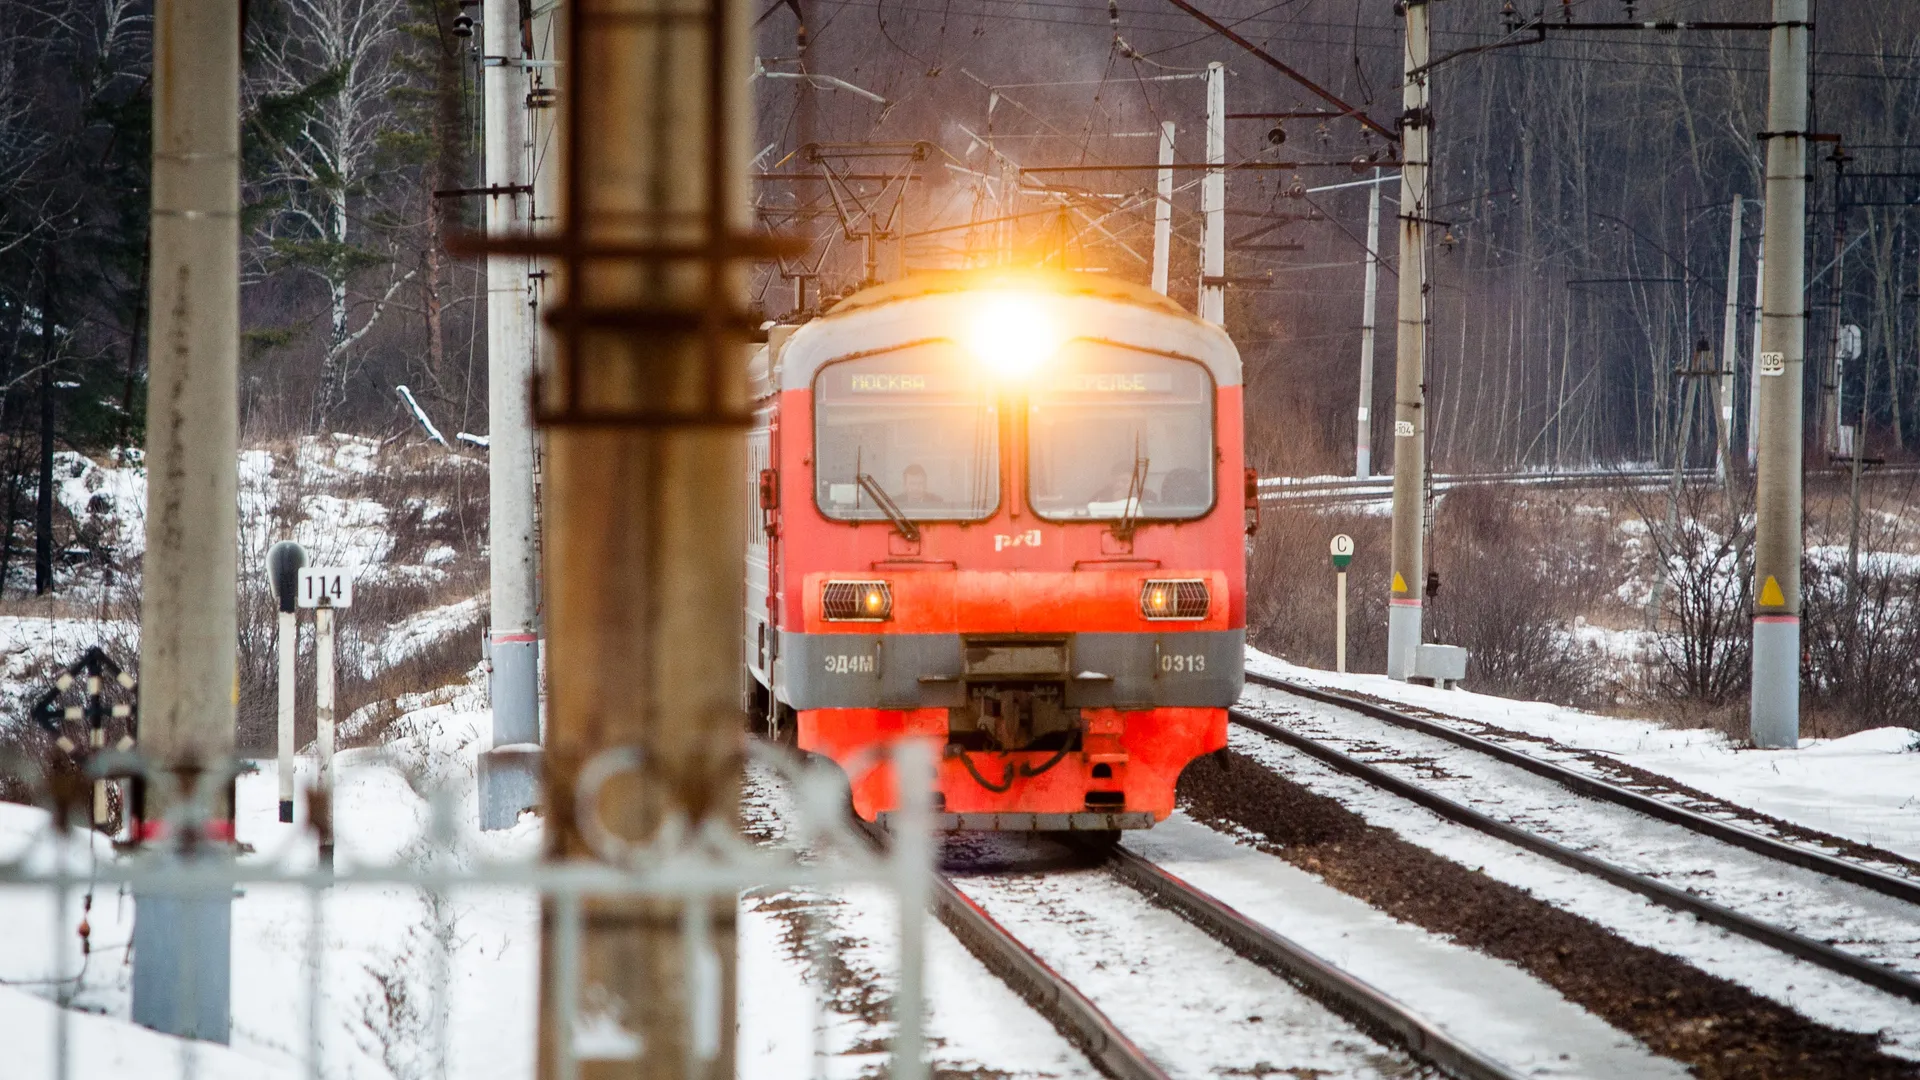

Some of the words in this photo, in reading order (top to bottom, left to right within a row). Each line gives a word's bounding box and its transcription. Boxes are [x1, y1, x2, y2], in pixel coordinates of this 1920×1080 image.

[1763, 354, 1780, 366] 106
[852, 374, 925, 392] МОСКВА
[1398, 425, 1411, 435] 104
[305, 575, 342, 600] 114
[824, 655, 873, 674] ЭД4М
[1161, 655, 1205, 672] 0313
